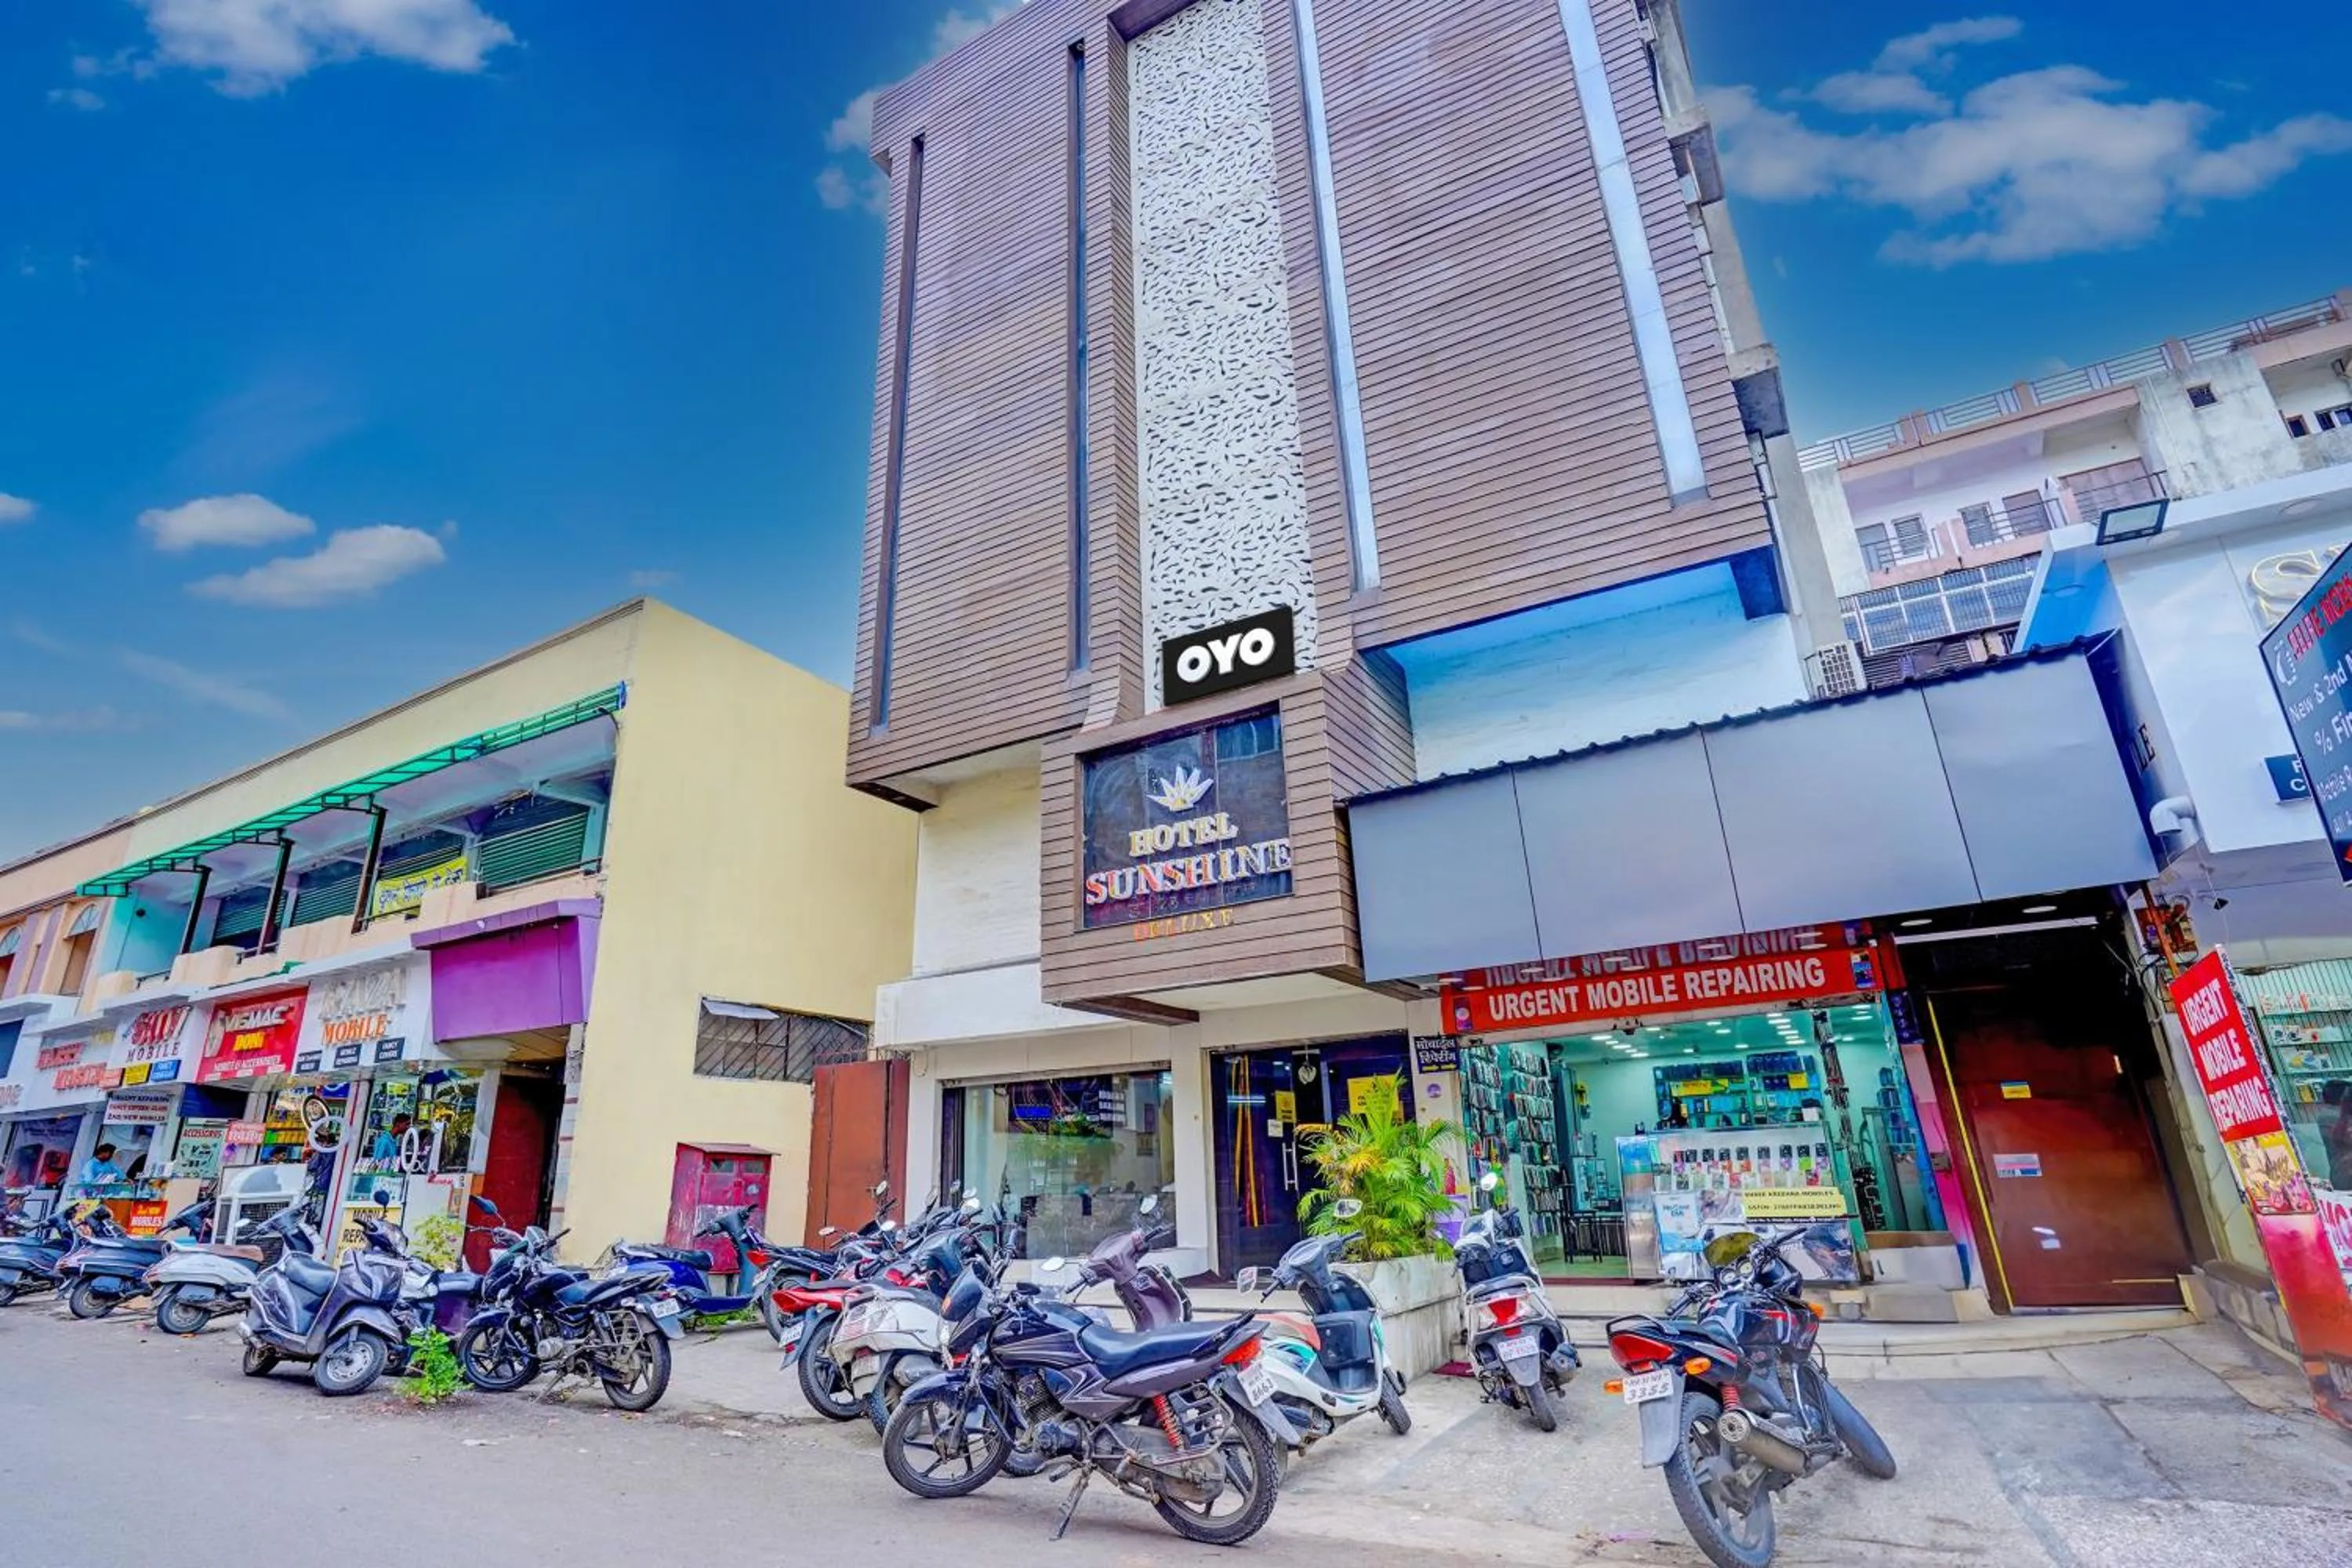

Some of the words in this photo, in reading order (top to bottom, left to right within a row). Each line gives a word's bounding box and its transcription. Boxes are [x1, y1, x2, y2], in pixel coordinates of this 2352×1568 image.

[1177, 628, 1276, 683] OYO
[1128, 811, 1239, 857] HOTEL
[1085, 838, 1292, 905] SUNSHINE
[1489, 985, 1579, 1020] URGENT
[1587, 973, 1679, 1011] MOBILE
[1683, 957, 1825, 1000] REPAIRING
[2181, 978, 2228, 1036] URGENT
[126, 1042, 180, 1062] MOBILE
[322, 1013, 388, 1046] MOBILE
[2198, 1028, 2247, 1082] MOBILE
